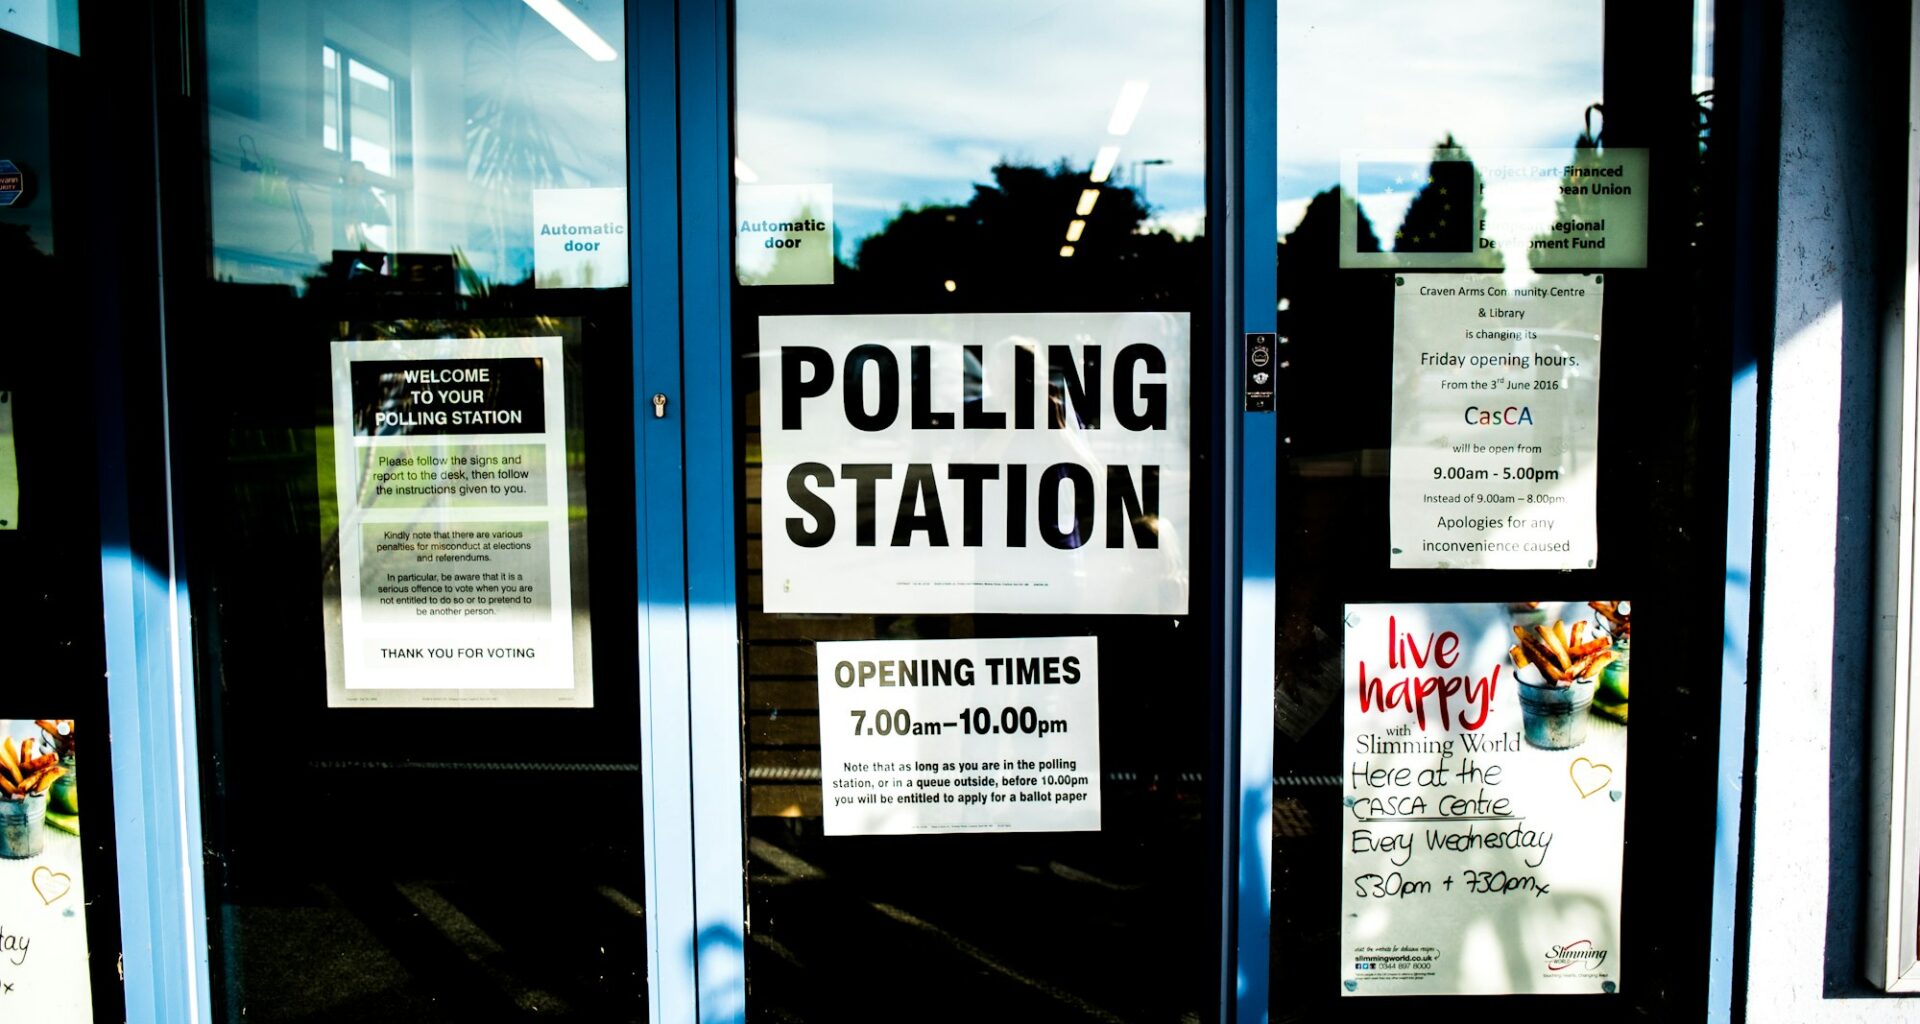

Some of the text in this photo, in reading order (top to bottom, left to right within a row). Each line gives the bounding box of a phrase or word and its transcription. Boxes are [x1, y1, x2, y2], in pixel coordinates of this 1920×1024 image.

[1530, 165, 1624, 177] Part-Financed
[1591, 183, 1632, 195] Union
[540, 222, 624, 236] Automatic
[739, 218, 825, 232] Automatic
[564, 239, 600, 252] door
[764, 236, 801, 249] door
[1571, 237, 1605, 249] Fund
[1419, 286, 1455, 296] Craven
[1458, 286, 1485, 296] Arms
[1549, 286, 1585, 297] Centre
[1489, 307, 1525, 320] Library
[1465, 328, 1538, 341] is changing its
[1421, 351, 1580, 369] Friday opening hours.
[403, 367, 491, 384] WELCOME
[780, 342, 1168, 432] POLLING
[1441, 379, 1468, 390] From
[1470, 379, 1488, 390] the
[1506, 380, 1530, 390] June
[1533, 380, 1559, 390] 2016
[410, 389, 485, 405] TO YOUR
[374, 409, 523, 427] POLLING STATION
[1464, 405, 1533, 425] CasCA
[1452, 443, 1541, 454] will be open from
[378, 454, 522, 468] Please follow the signs and
[372, 468, 529, 483] report to the desk, then follow
[1433, 466, 1560, 483] 9.00am 5.00pm
[375, 483, 528, 497] the instructions given to you.
[1423, 493, 1515, 503] Instead of 9.00am
[785, 461, 1160, 550] STATION
[1437, 515, 1554, 531] Apologies for any
[384, 530, 523, 541] Kindly note that there are various
[376, 541, 531, 552] penalties for misconduct at elections
[1422, 539, 1570, 552] inconvenience caused
[416, 552, 492, 562] and referendums.
[386, 573, 395, 581] In
[397, 572, 438, 583] particular,
[440, 572, 452, 581] be
[482, 572, 498, 581] that
[508, 572, 515, 581] is
[377, 585, 409, 593] serious
[410, 584, 442, 593] offence
[444, 584, 453, 593] to
[454, 584, 474, 593] vote
[475, 583, 499, 592] when
[500, 585, 517, 594] you
[379, 595, 532, 605] not entitled to do so or to pretend to
[415, 606, 497, 617] be another person.
[1389, 615, 1460, 669] live
[380, 647, 536, 659] THANK YOU FOR VOTING
[834, 655, 1081, 689] OPENING TIMES
[1359, 660, 1501, 732] happy!
[1385, 723, 1412, 738] with
[1355, 731, 1521, 759] Slimming World
[843, 757, 1076, 772] Note that as long as you are in the polling
[1352, 758, 1502, 788] Here at the
[832, 774, 1088, 789] station, or in a queue outside, before 10.00pm
[834, 790, 1087, 807] you will be entitled to apply for a ballot paper
[1352, 788, 1513, 819] CASCA Centre
[1352, 822, 1553, 867] Every Wednesday
[1545, 945, 1608, 970] Slimming
